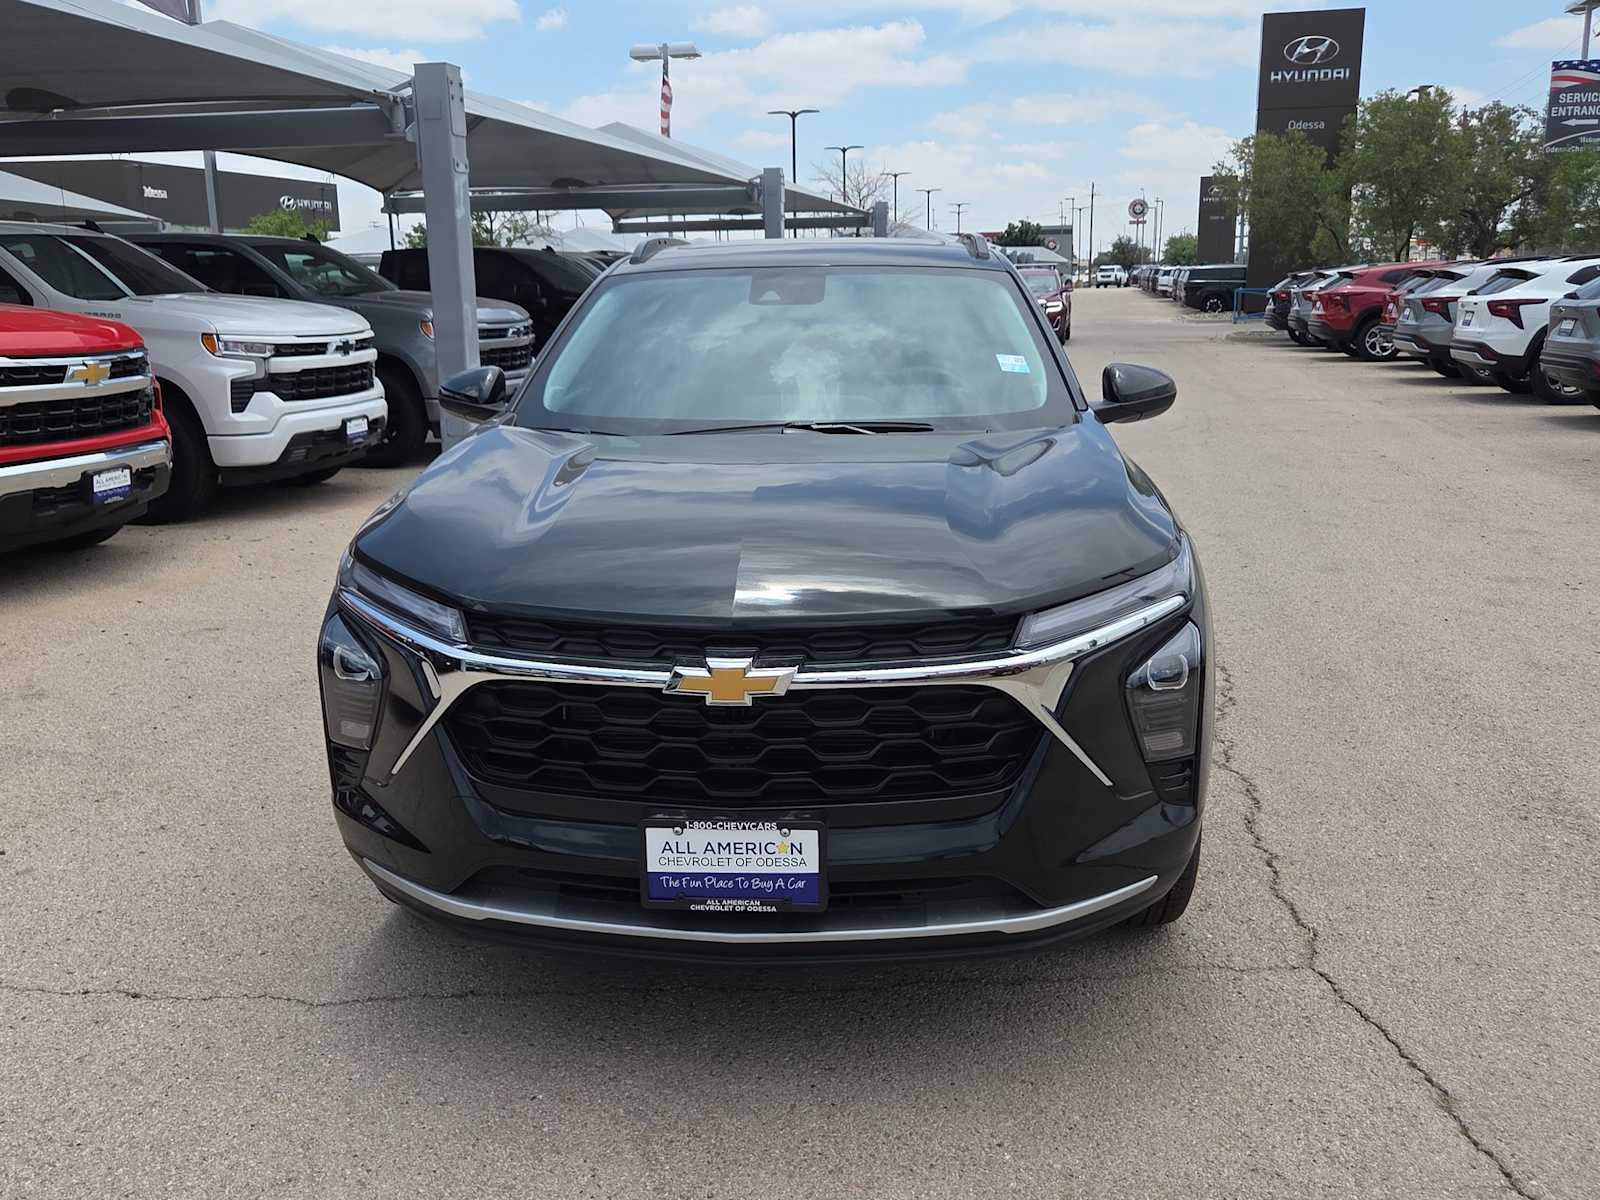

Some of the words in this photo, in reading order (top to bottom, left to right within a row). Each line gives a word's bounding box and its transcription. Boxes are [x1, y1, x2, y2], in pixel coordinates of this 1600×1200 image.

[1270, 68, 1350, 83] HYUNDAI
[1559, 92, 1600, 103] SERVIC
[1551, 105, 1600, 116] ENTRANC
[1288, 120, 1325, 129] Odessa
[685, 821, 778, 831] 1-800-CHEVYCARS
[661, 841, 697, 854] ALL
[658, 856, 732, 867] CHEVROLET
[735, 857, 752, 867] OF
[756, 857, 807, 867] ODESSA
[659, 876, 681, 888] The
[681, 877, 703, 888] Fun
[703, 876, 734, 889] Place
[735, 877, 749, 889] To
[751, 877, 774, 892] Buy
[775, 878, 785, 889] A
[787, 877, 806, 889] Car
